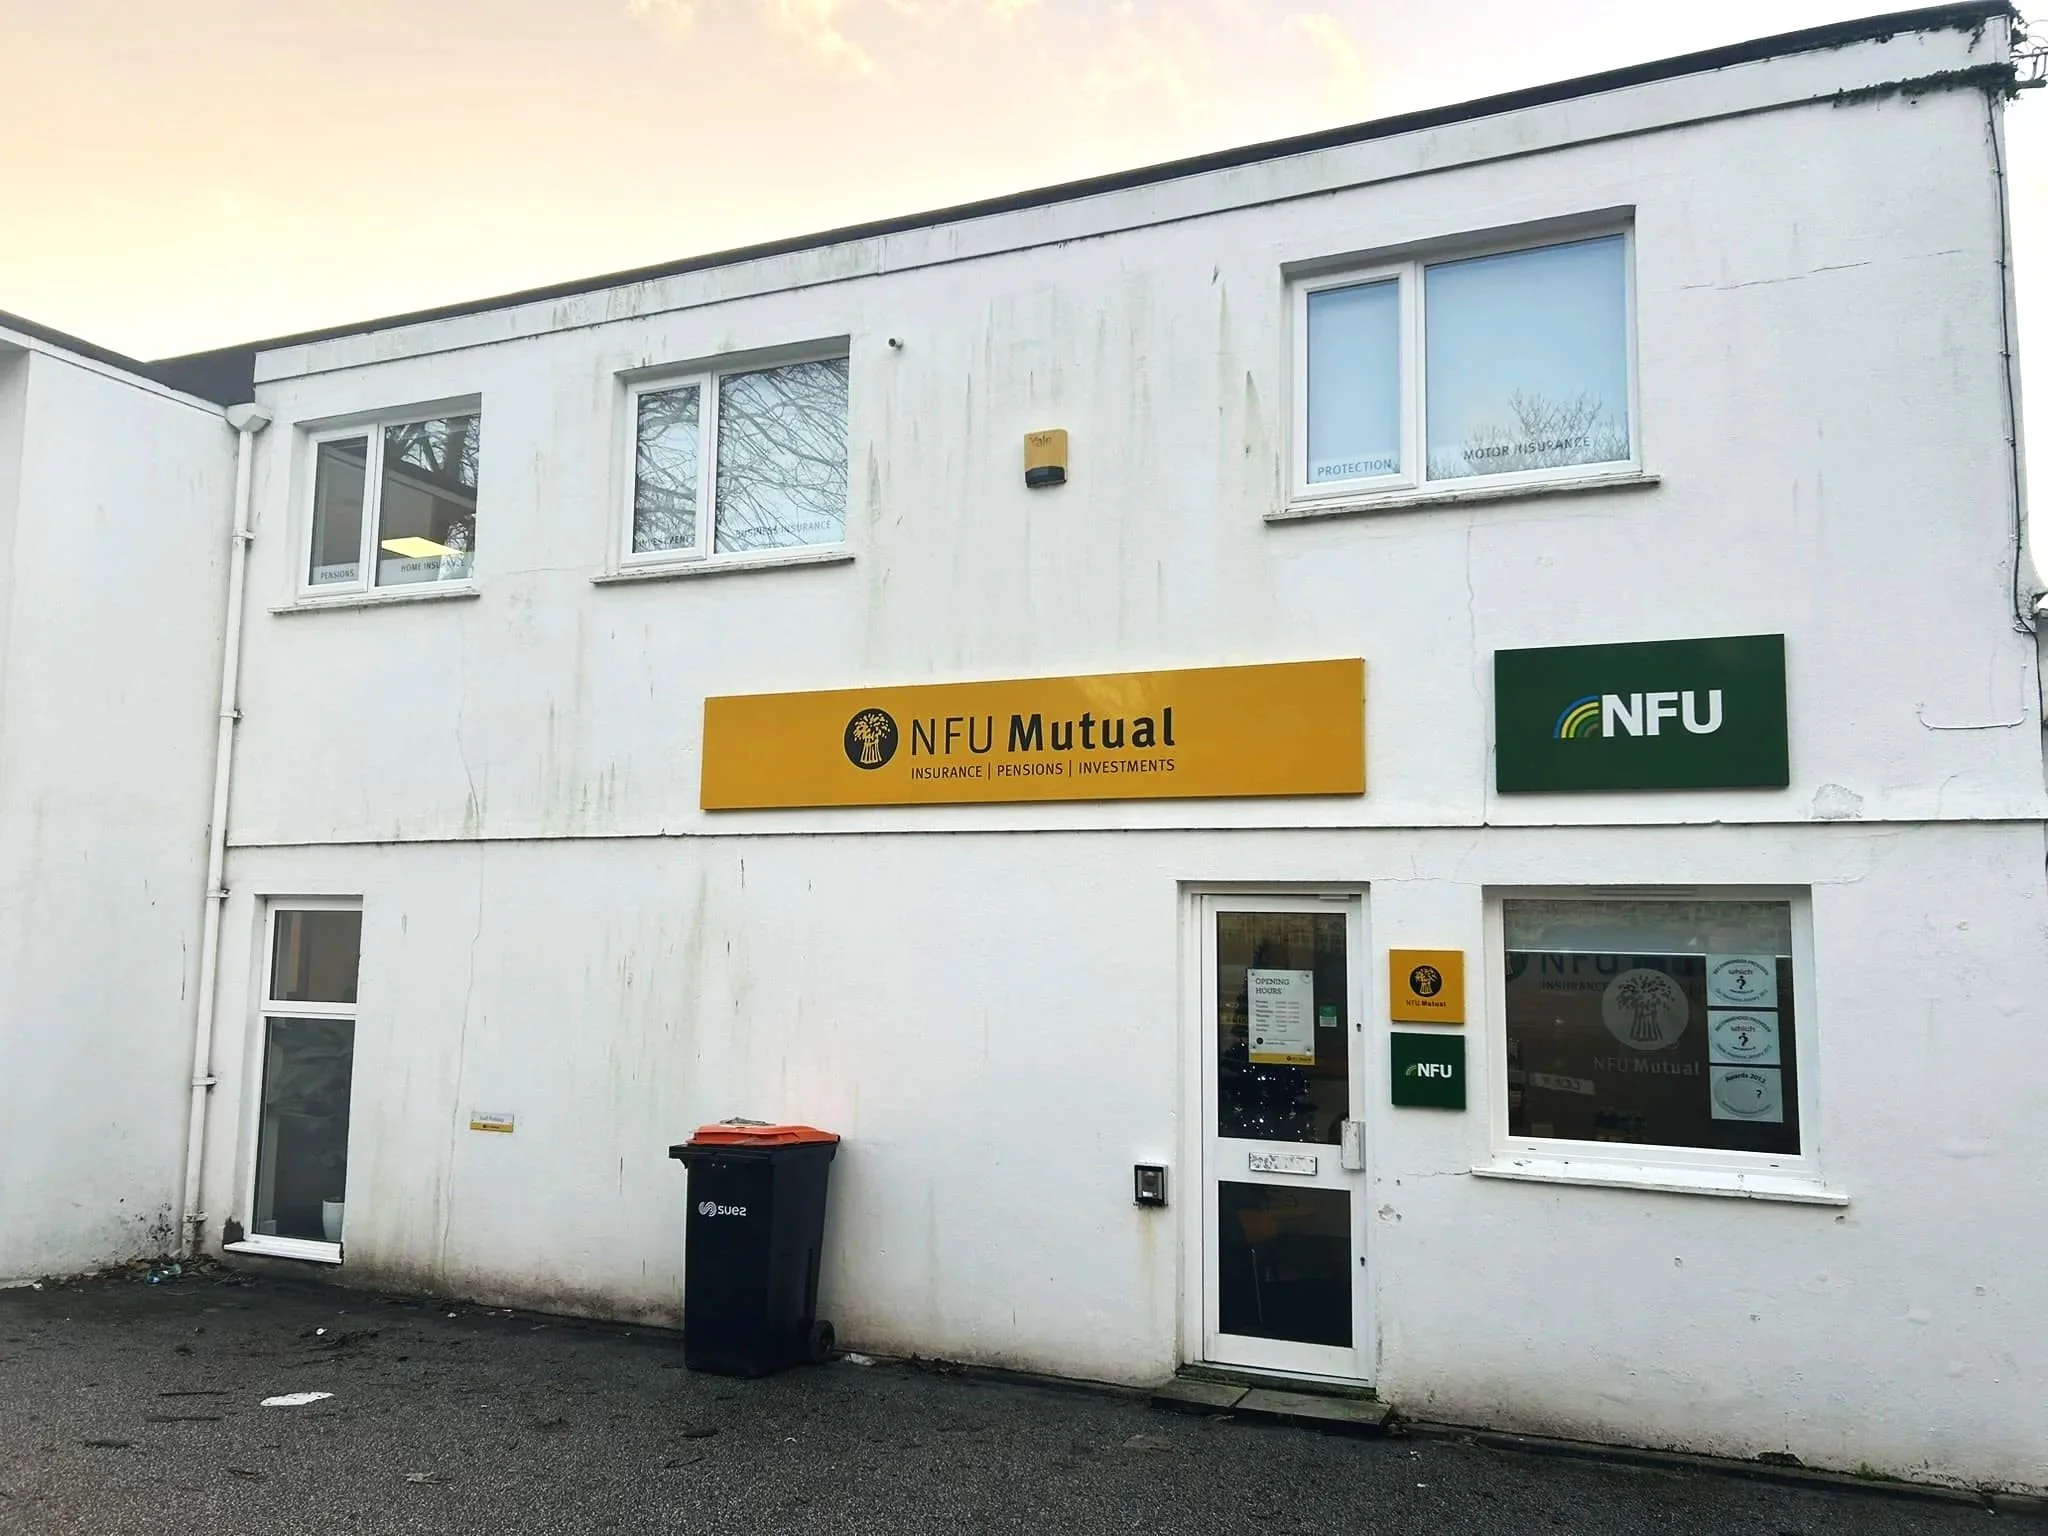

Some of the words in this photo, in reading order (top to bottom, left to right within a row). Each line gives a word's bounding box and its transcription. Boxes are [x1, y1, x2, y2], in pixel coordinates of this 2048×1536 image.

[1463, 444, 1510, 460] MOTOR
[1513, 436, 1591, 455] INSURANCE
[1317, 459, 1392, 477] PROTECTION
[735, 526, 777, 540] BUSINESS
[777, 520, 832, 535] INSURANCE
[400, 562, 421, 573] HOME
[320, 568, 354, 580] PENSIONS
[1602, 688, 1723, 739] NFU
[910, 715, 994, 757] NFU
[1007, 706, 1176, 753] Mutual
[910, 764, 983, 781] INSURANCE
[996, 762, 1063, 778] PENSIONS
[1077, 758, 1176, 775] INVESTMENTS
[1728, 967, 1753, 975] which
[1255, 977, 1290, 986] OPENING
[1255, 987, 1283, 995] HOURS
[1405, 998, 1421, 1007] NFU
[1421, 999, 1447, 1008] Mutual
[1731, 1025, 1755, 1033] which
[1417, 1063, 1453, 1079] NFU
[1592, 1055, 1629, 1073] NFU
[1634, 1058, 1701, 1077] Mutual
[1725, 1072, 1749, 1083] Awards
[717, 1205, 747, 1216] suez
